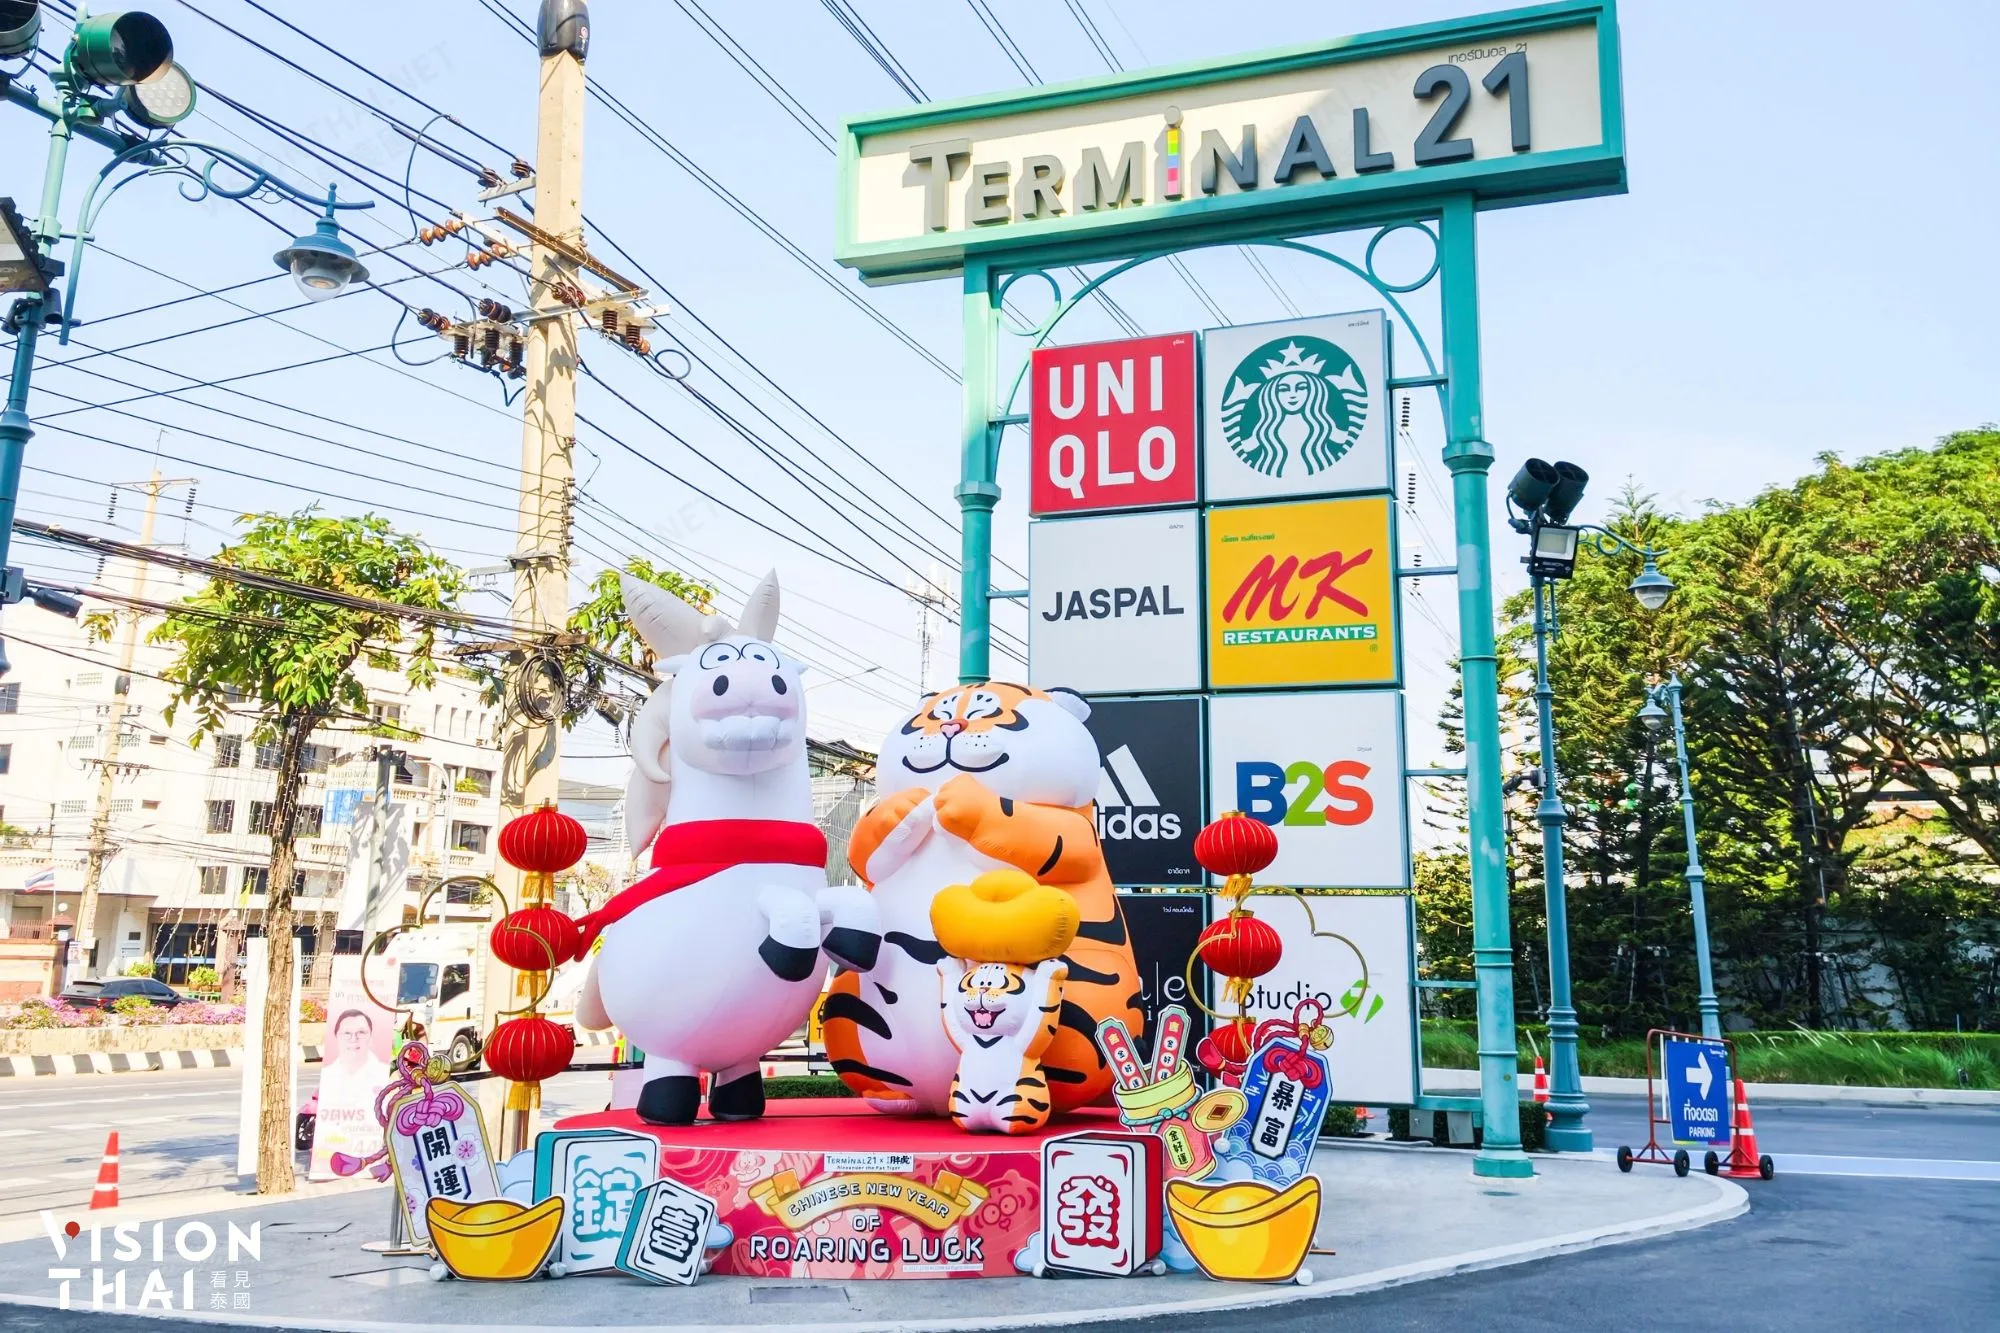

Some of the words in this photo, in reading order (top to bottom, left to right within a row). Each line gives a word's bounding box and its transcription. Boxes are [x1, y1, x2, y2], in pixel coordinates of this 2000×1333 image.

[1048, 355, 1164, 420] UNI
[1048, 425, 1176, 500] QLO
[1042, 584, 1185, 622] JASPAL
[1222, 548, 1374, 624] MK
[1223, 625, 1376, 645] RESTAURANTS
[1236, 760, 1374, 827] B2S
[1683, 1098, 1719, 1122] ที่จอดรถ
[1688, 1126, 1716, 1138] PARKING
[422, 1126, 463, 1196] 開運
[788, 1183, 861, 1217] CHINESE
[866, 1183, 901, 1198] NEW
[906, 1189, 950, 1219] YEAR
[1057, 1175, 1121, 1249] 發
[852, 1215, 881, 1232] OF
[750, 1236, 890, 1263] ROARING
[901, 1236, 985, 1263] LUCK
